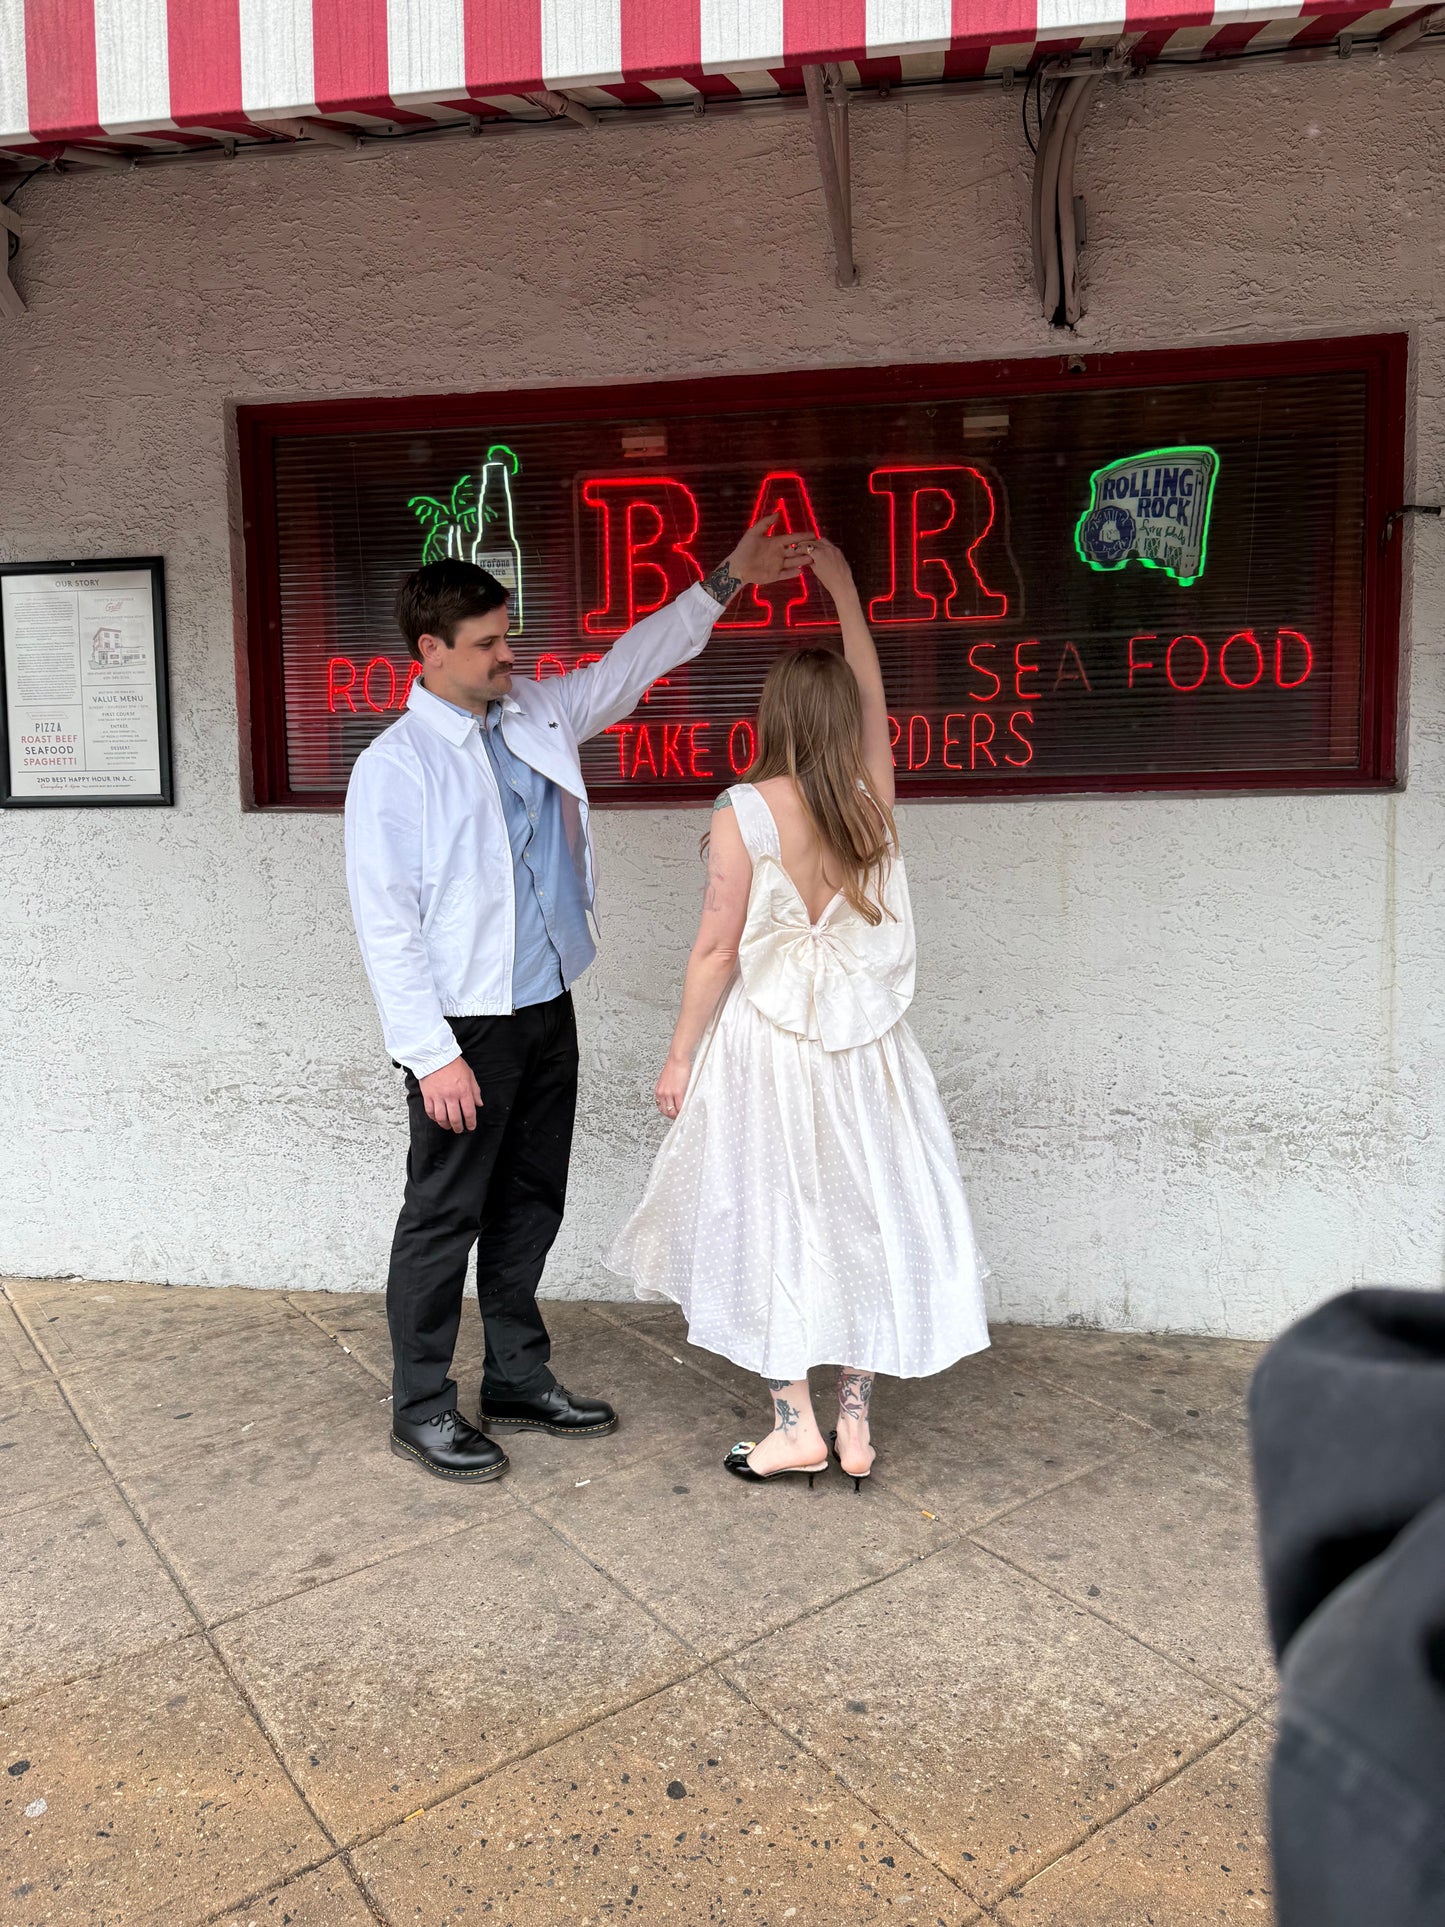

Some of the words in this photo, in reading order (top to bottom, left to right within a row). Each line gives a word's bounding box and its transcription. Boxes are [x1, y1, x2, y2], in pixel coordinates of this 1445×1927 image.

[1102, 467, 1194, 501] ROLLING
[1136, 497, 1191, 527] ROCK
[583, 465, 1008, 635] BAR
[55, 580, 73, 588] OUR
[74, 579, 100, 587] STORY
[967, 640, 1093, 701] SEA
[1127, 627, 1313, 692] FOOD
[35, 722, 62, 733] PIZZA
[21, 735, 52, 744] ROAST
[55, 734, 78, 743] BEEF
[25, 746, 74, 755] SEAFOOD
[604, 722, 714, 778] TAKE
[23, 757, 77, 766] SPAGHETTI
